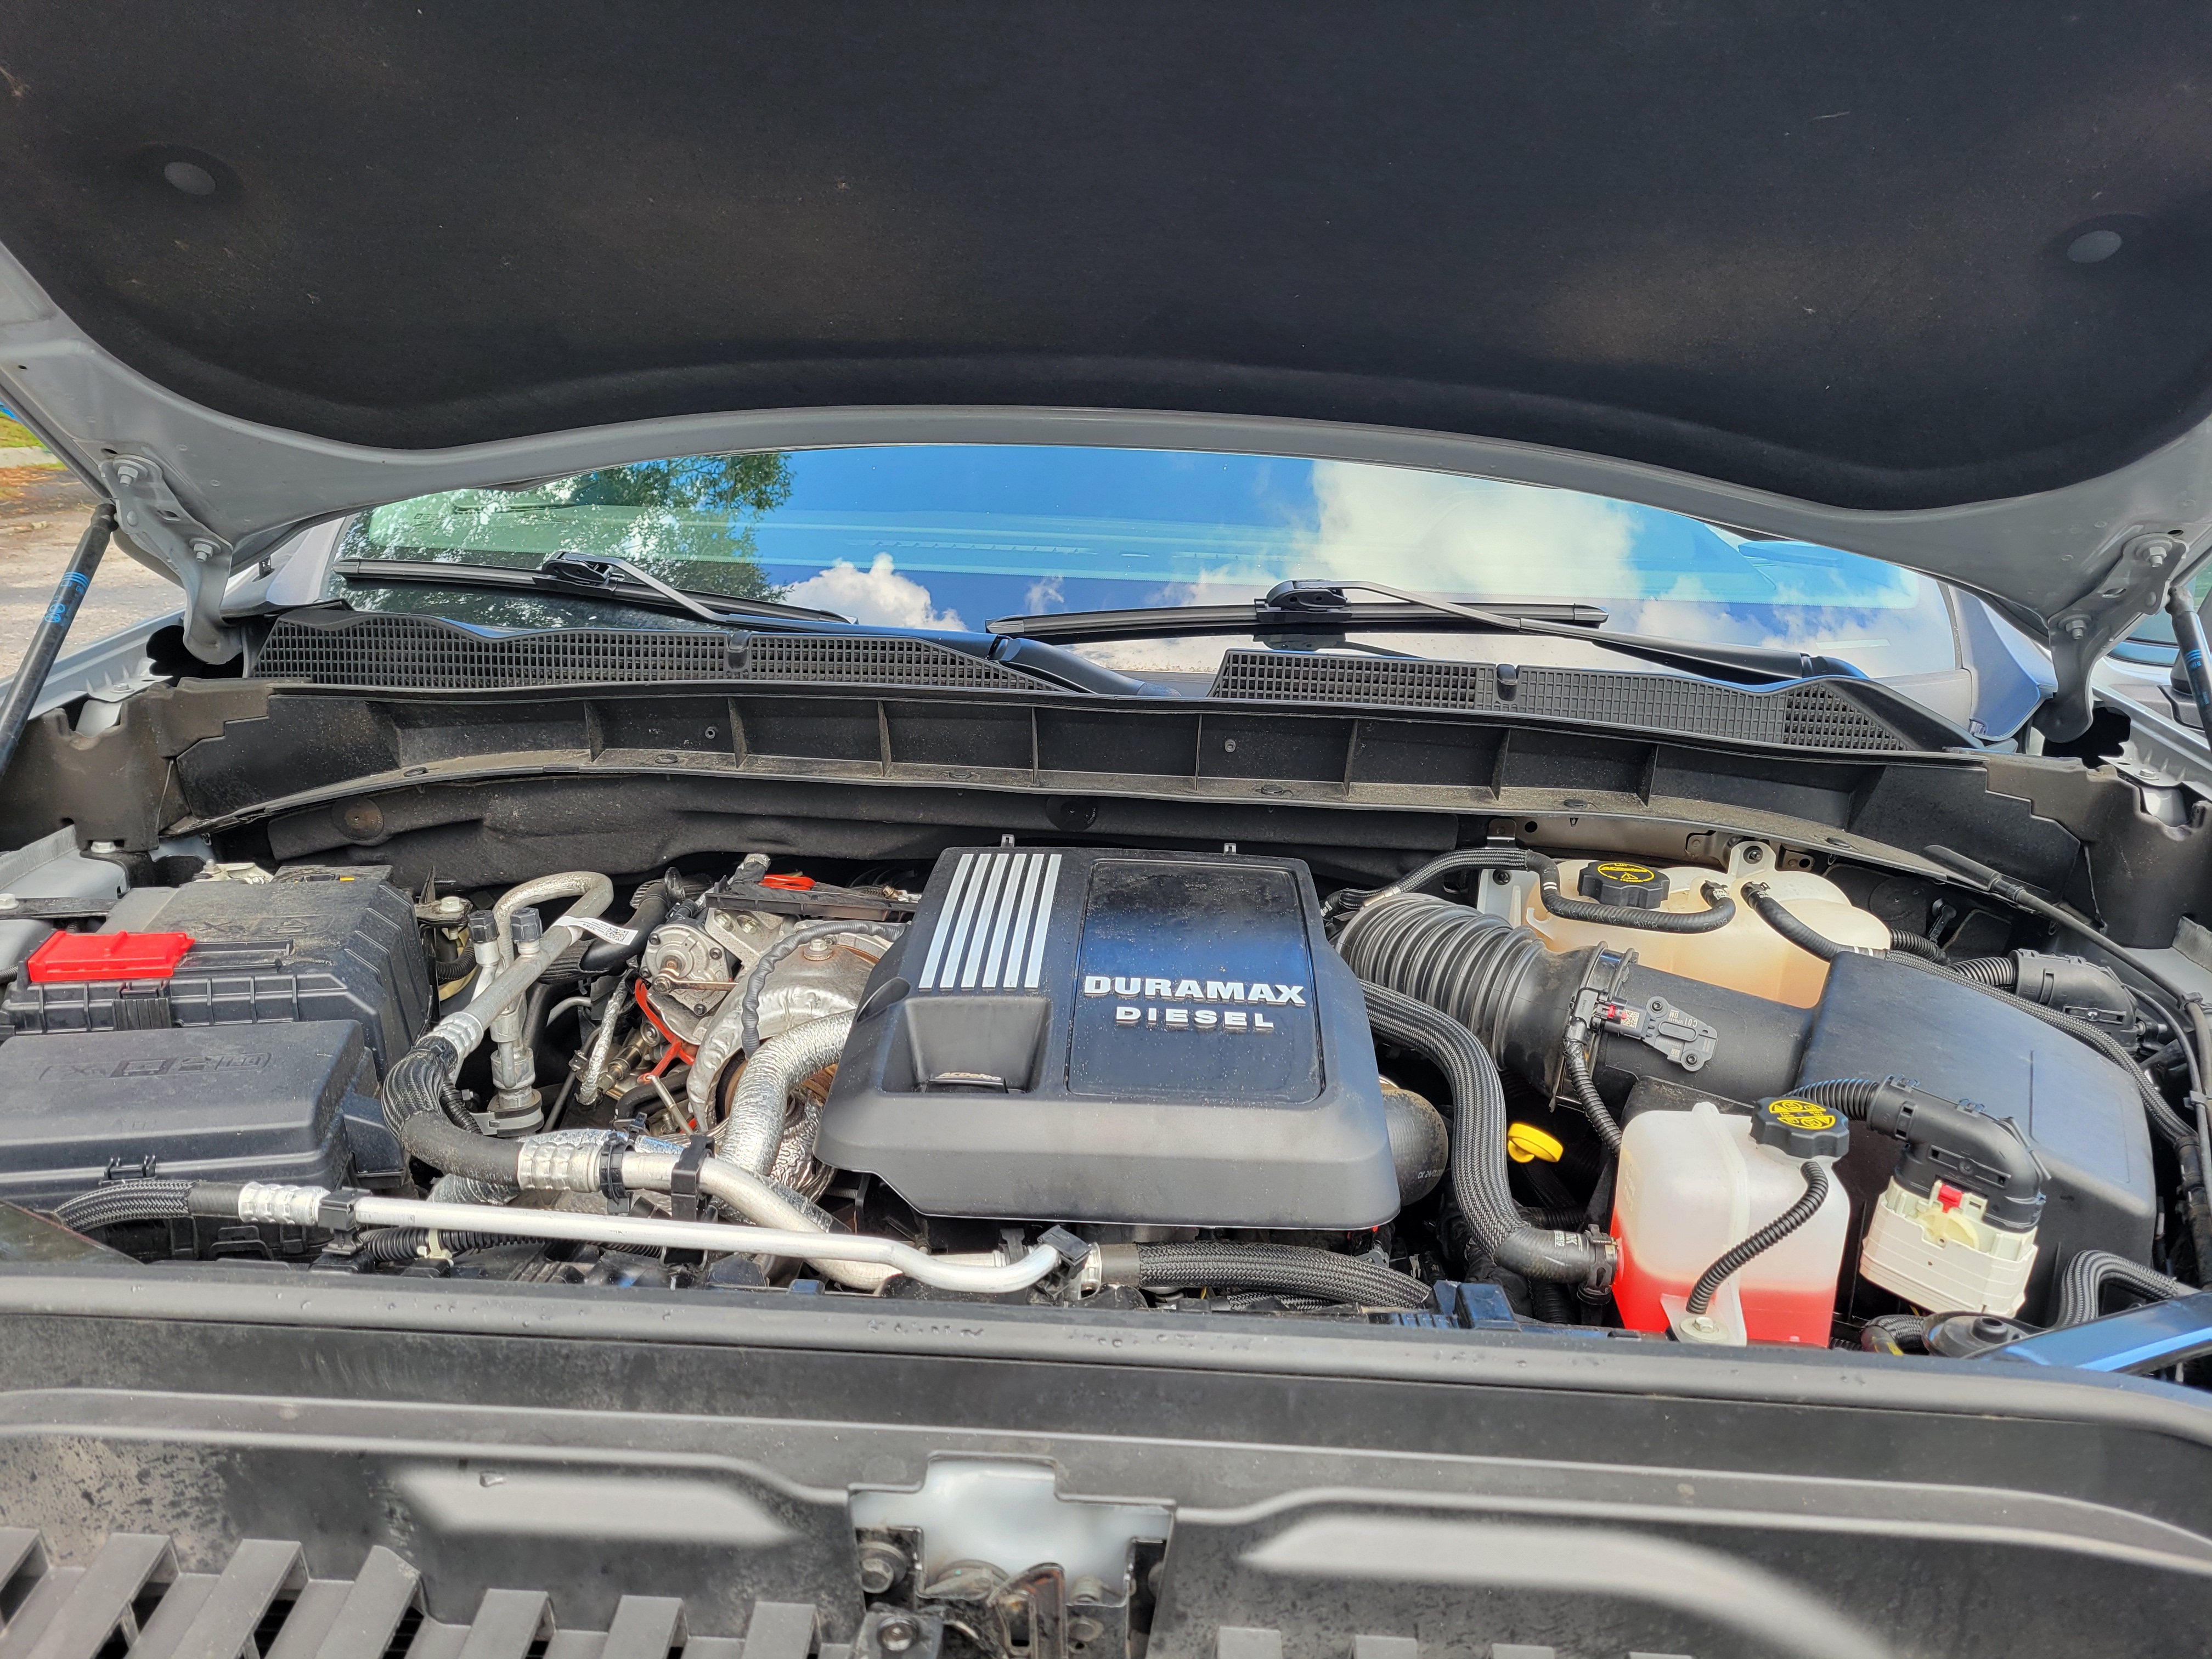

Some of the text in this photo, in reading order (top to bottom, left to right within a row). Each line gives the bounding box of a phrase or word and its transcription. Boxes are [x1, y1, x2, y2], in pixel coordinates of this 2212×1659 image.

[1084, 976, 1306, 1007] DURAMAX
[1116, 1006, 1274, 1030] DIESEL
[1669, 1009, 1679, 1019] GM
[935, 1072, 1002, 1081] ACDelco
